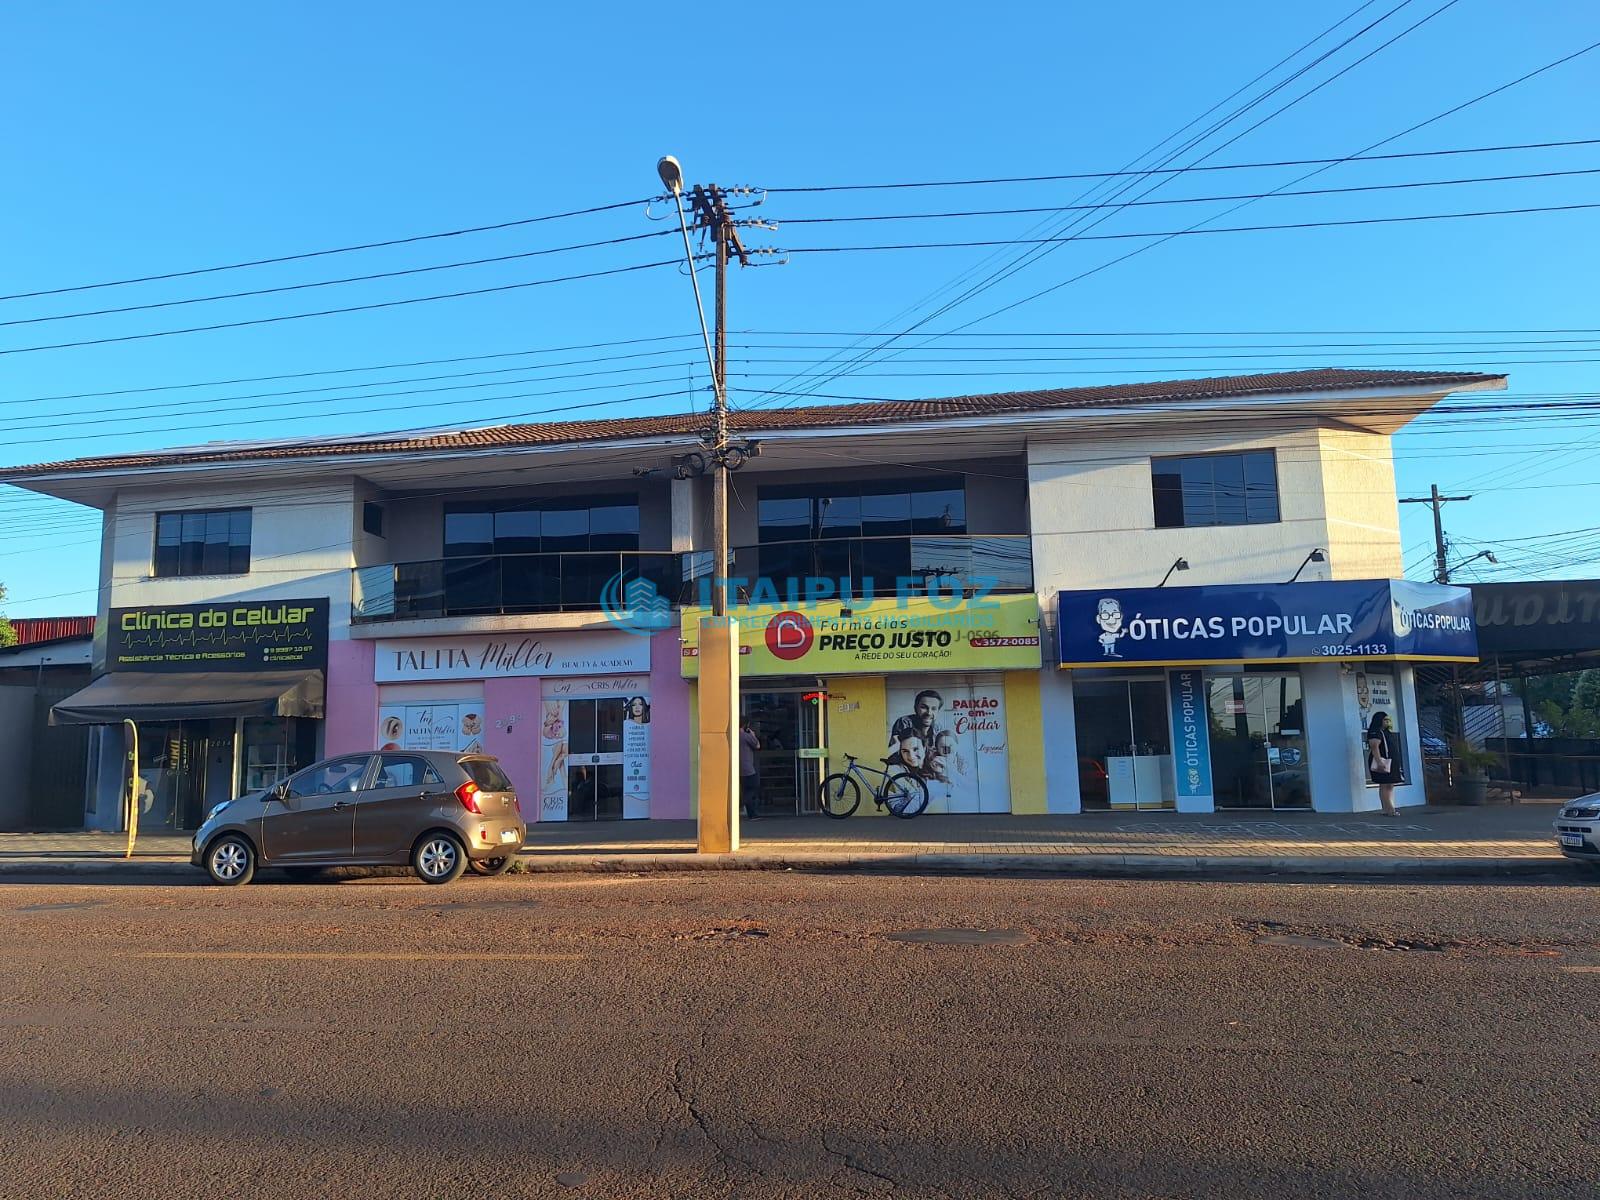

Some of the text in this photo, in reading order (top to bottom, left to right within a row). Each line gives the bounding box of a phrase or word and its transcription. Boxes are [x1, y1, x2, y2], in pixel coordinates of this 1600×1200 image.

[121, 605, 315, 631] Clínica do Celular
[1129, 612, 1353, 640] ÓTICAS POPULAR
[1400, 606, 1472, 631] ÓTICAS POPULAR
[819, 633, 885, 652] PREÇO
[888, 631, 952, 649] JUSTO
[983, 638, 1038, 646] 3572-0085
[392, 638, 555, 672] TALITA Müller
[861, 652, 880, 660] REDE
[882, 652, 895, 660] DO
[896, 651, 911, 659] SEU
[1322, 644, 1387, 656] 3025-1133
[562, 660, 591, 668] BEAUTY
[600, 659, 633, 667] ACADEMY
[591, 681, 610, 690] CRIS
[952, 697, 999, 709] PAIXÃO
[1181, 673, 1199, 766] ÓTICAS POPULAR
